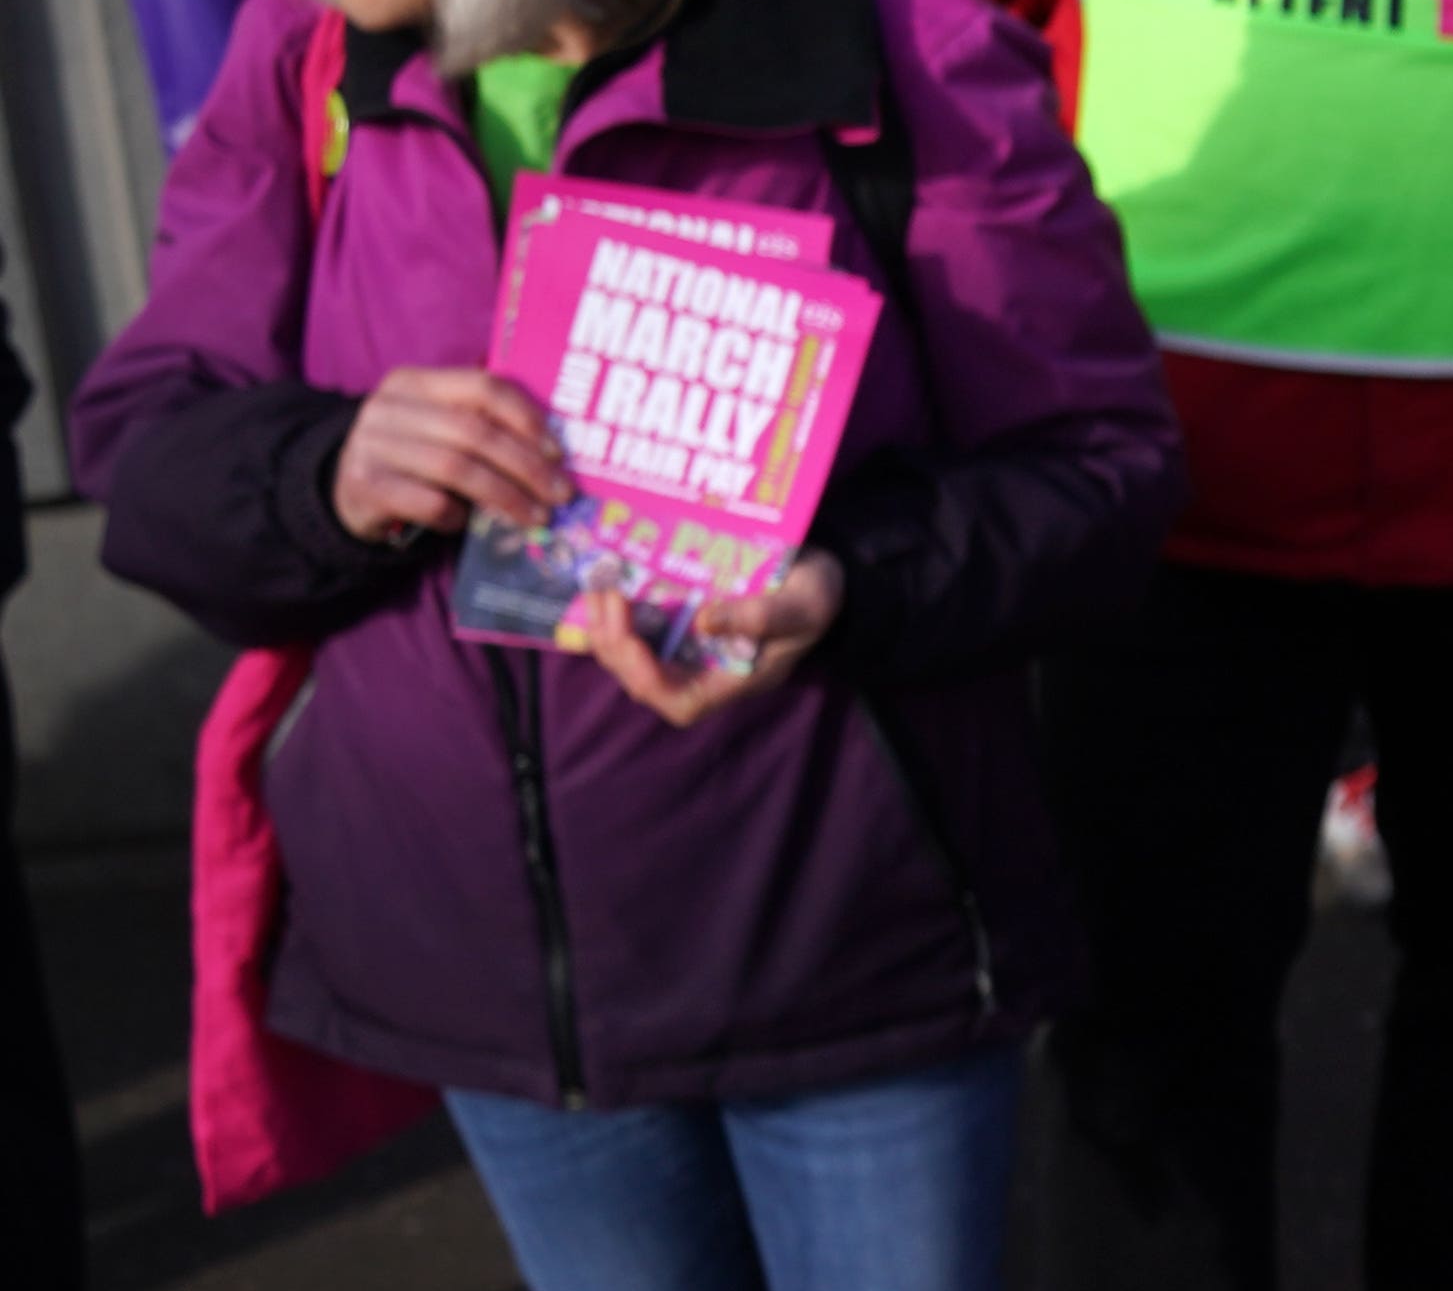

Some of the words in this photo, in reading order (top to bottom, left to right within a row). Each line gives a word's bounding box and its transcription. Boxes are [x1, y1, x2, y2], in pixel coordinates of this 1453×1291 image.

[589, 238, 802, 341] NATIONAL
[570, 288, 796, 402] MARCH
[596, 363, 777, 460] RALLY
